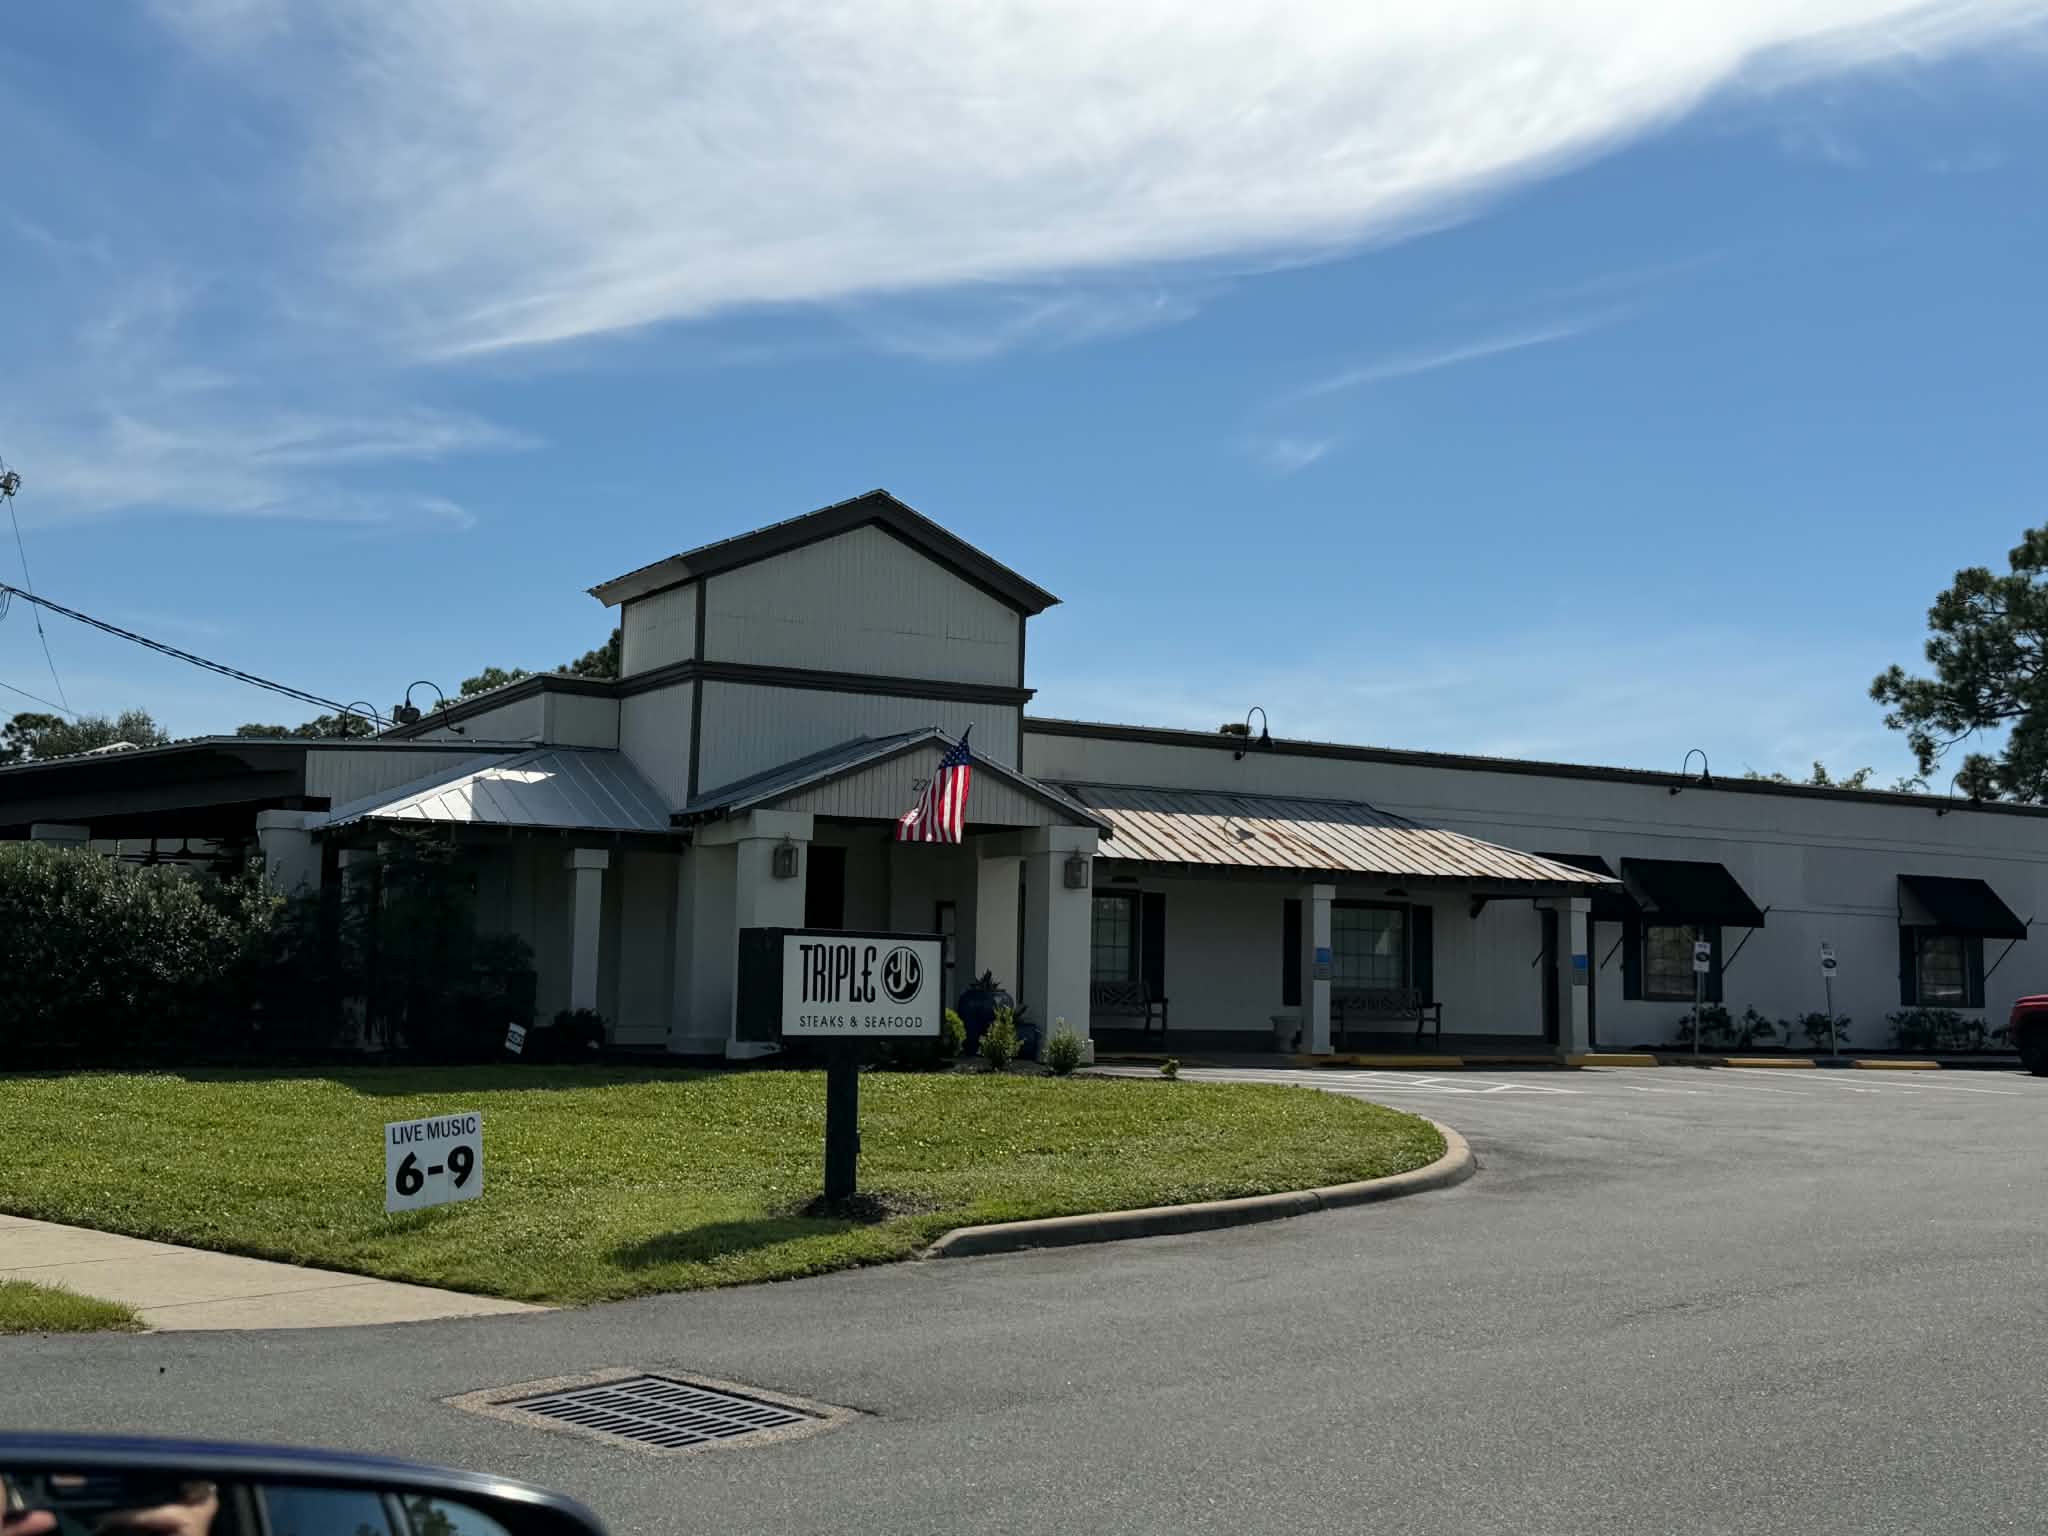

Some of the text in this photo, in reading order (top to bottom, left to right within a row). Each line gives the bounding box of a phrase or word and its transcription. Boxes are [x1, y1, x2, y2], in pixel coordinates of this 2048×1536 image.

[799, 943, 877, 1004] TRIPLE
[799, 1015, 923, 1029] STEAKS & SEAFOOD
[392, 1116, 476, 1145] LIVE MUSIC
[395, 1145, 475, 1196] 6-9
